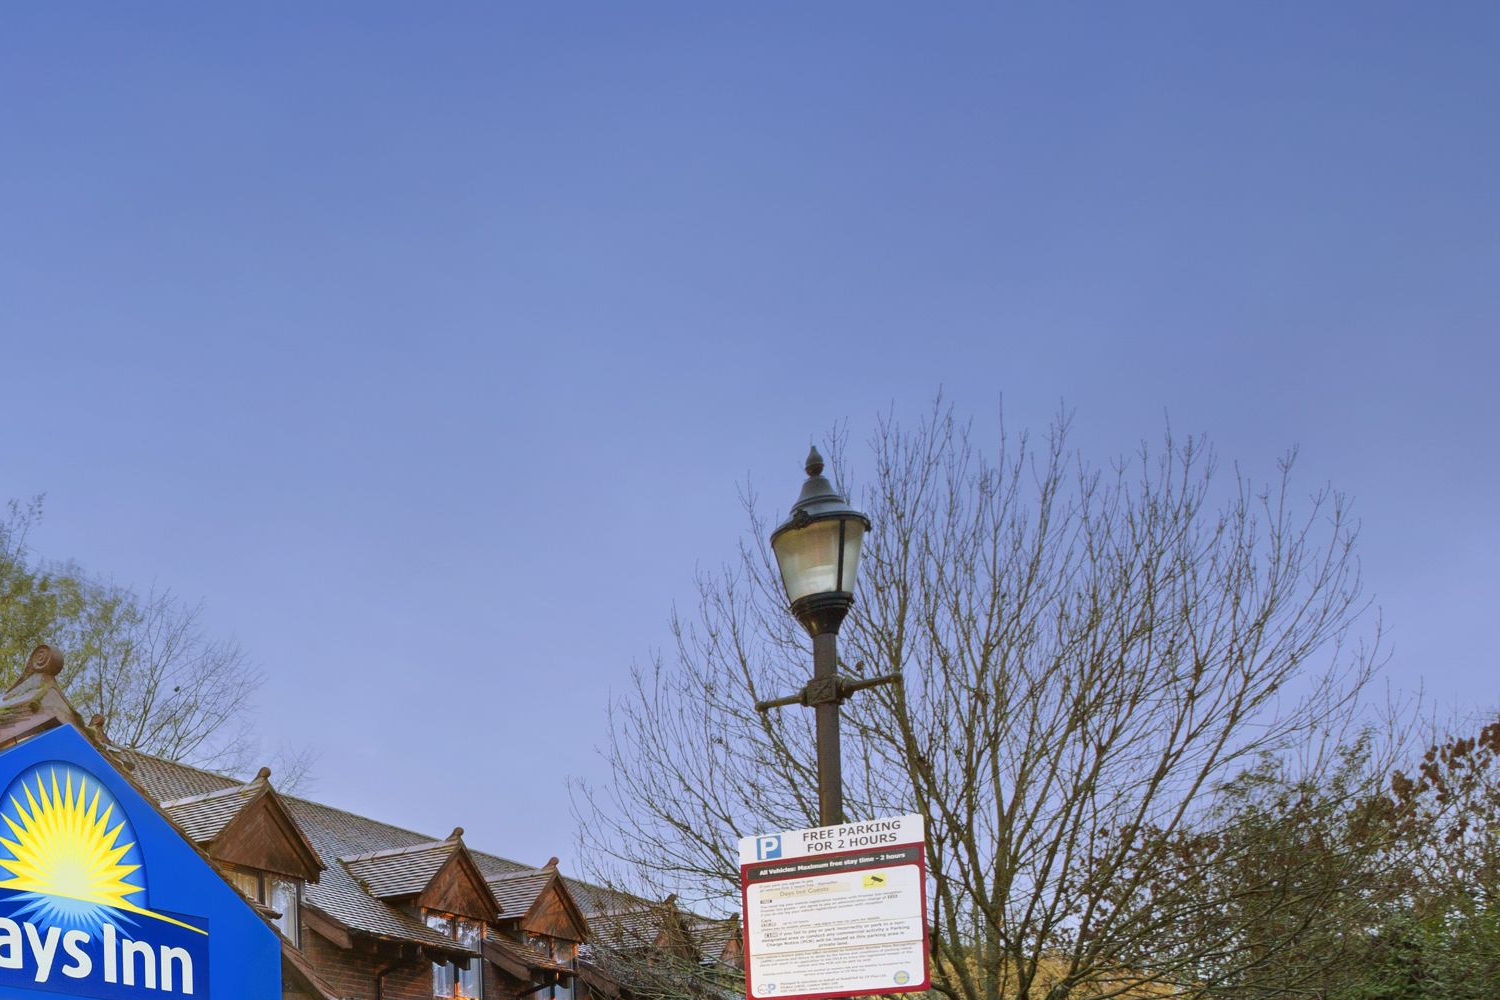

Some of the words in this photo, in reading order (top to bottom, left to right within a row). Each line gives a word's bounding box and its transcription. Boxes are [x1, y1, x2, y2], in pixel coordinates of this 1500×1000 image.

[803, 828, 834, 842] FREE
[839, 820, 901, 836] PARKING
[761, 837, 778, 859] P
[807, 841, 833, 853] FOR
[838, 839, 845, 849] 2
[850, 832, 897, 847] HOURS
[769, 866, 796, 875] Vehicles:
[798, 862, 829, 872] Maximum
[830, 859, 843, 867] free
[844, 858, 858, 867] stay
[859, 856, 874, 864] time
[886, 852, 906, 860] hours
[103, 923, 193, 994] Inn
